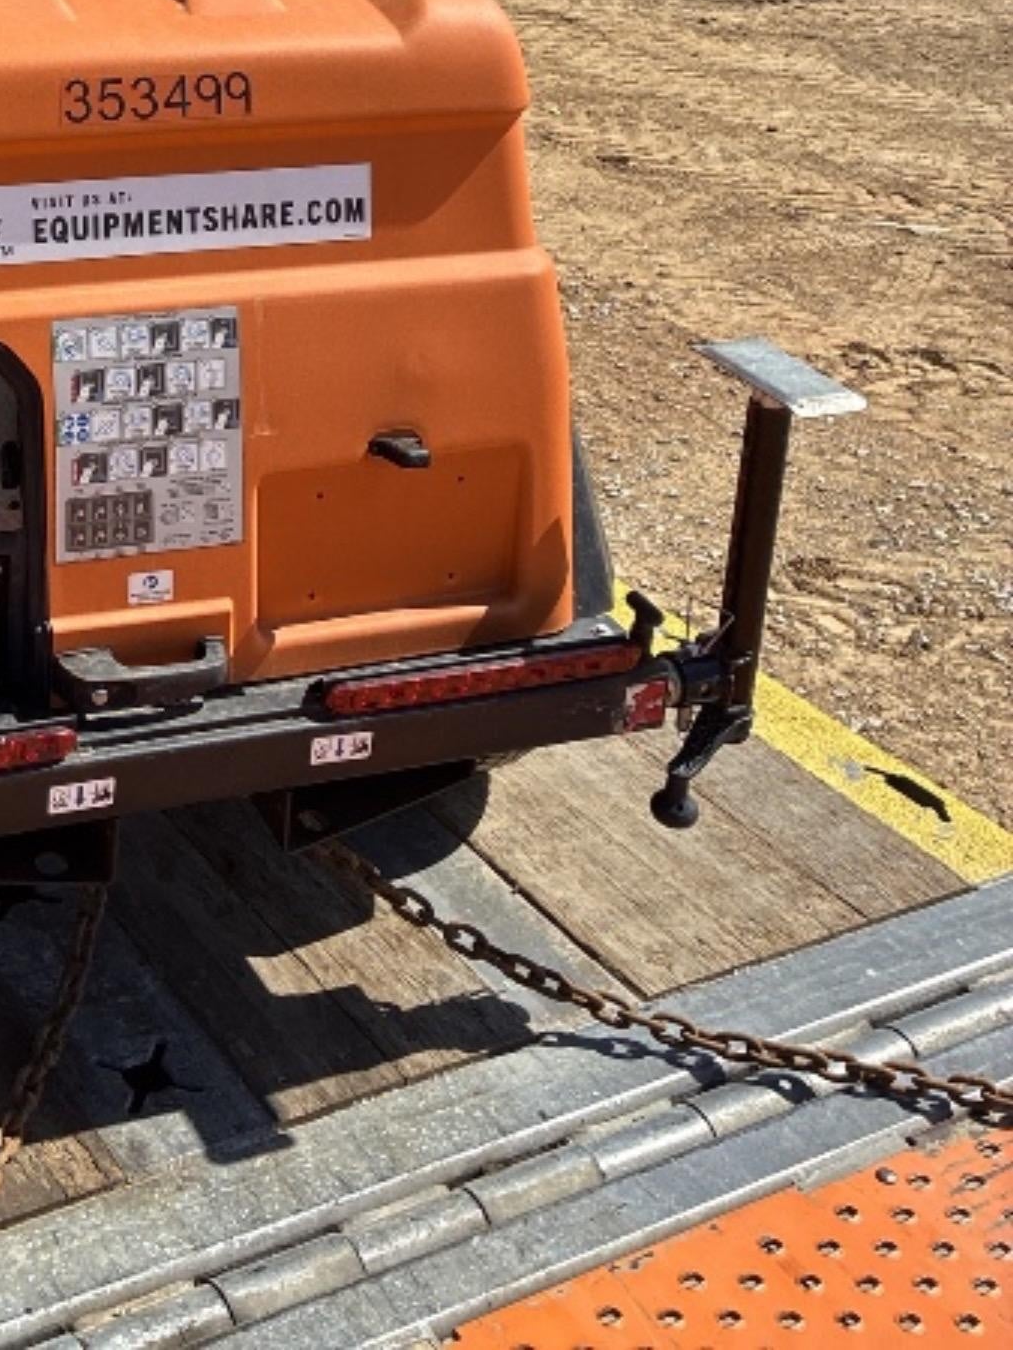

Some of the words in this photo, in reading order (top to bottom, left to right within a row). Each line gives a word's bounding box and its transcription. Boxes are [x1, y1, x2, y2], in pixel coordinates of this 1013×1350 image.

[64, 72, 252, 124] 353499
[31, 194, 75, 210] VISIT
[33, 197, 366, 244] EQUIPMENTSHARE.COM
